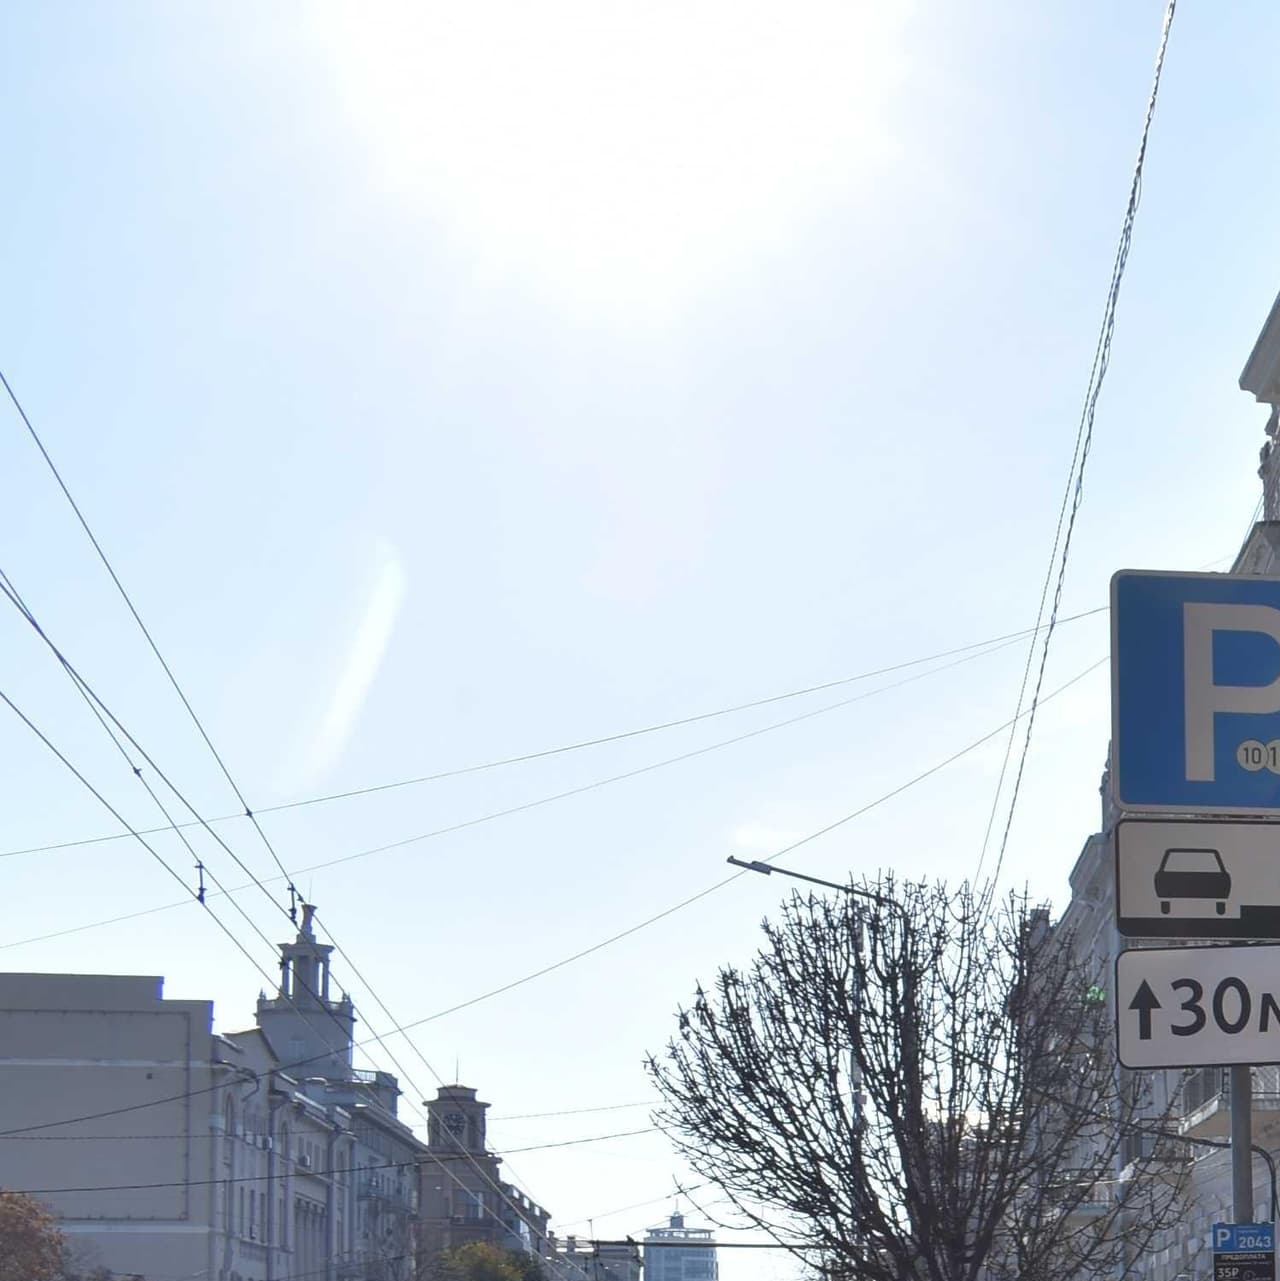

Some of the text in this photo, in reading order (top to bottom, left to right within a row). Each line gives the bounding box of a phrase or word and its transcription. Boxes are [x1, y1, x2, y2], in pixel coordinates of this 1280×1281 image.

[1243, 746, 1263, 765] 10
[1217, 1228, 1231, 1248] P
[1239, 1236, 1271, 1249] 2043
